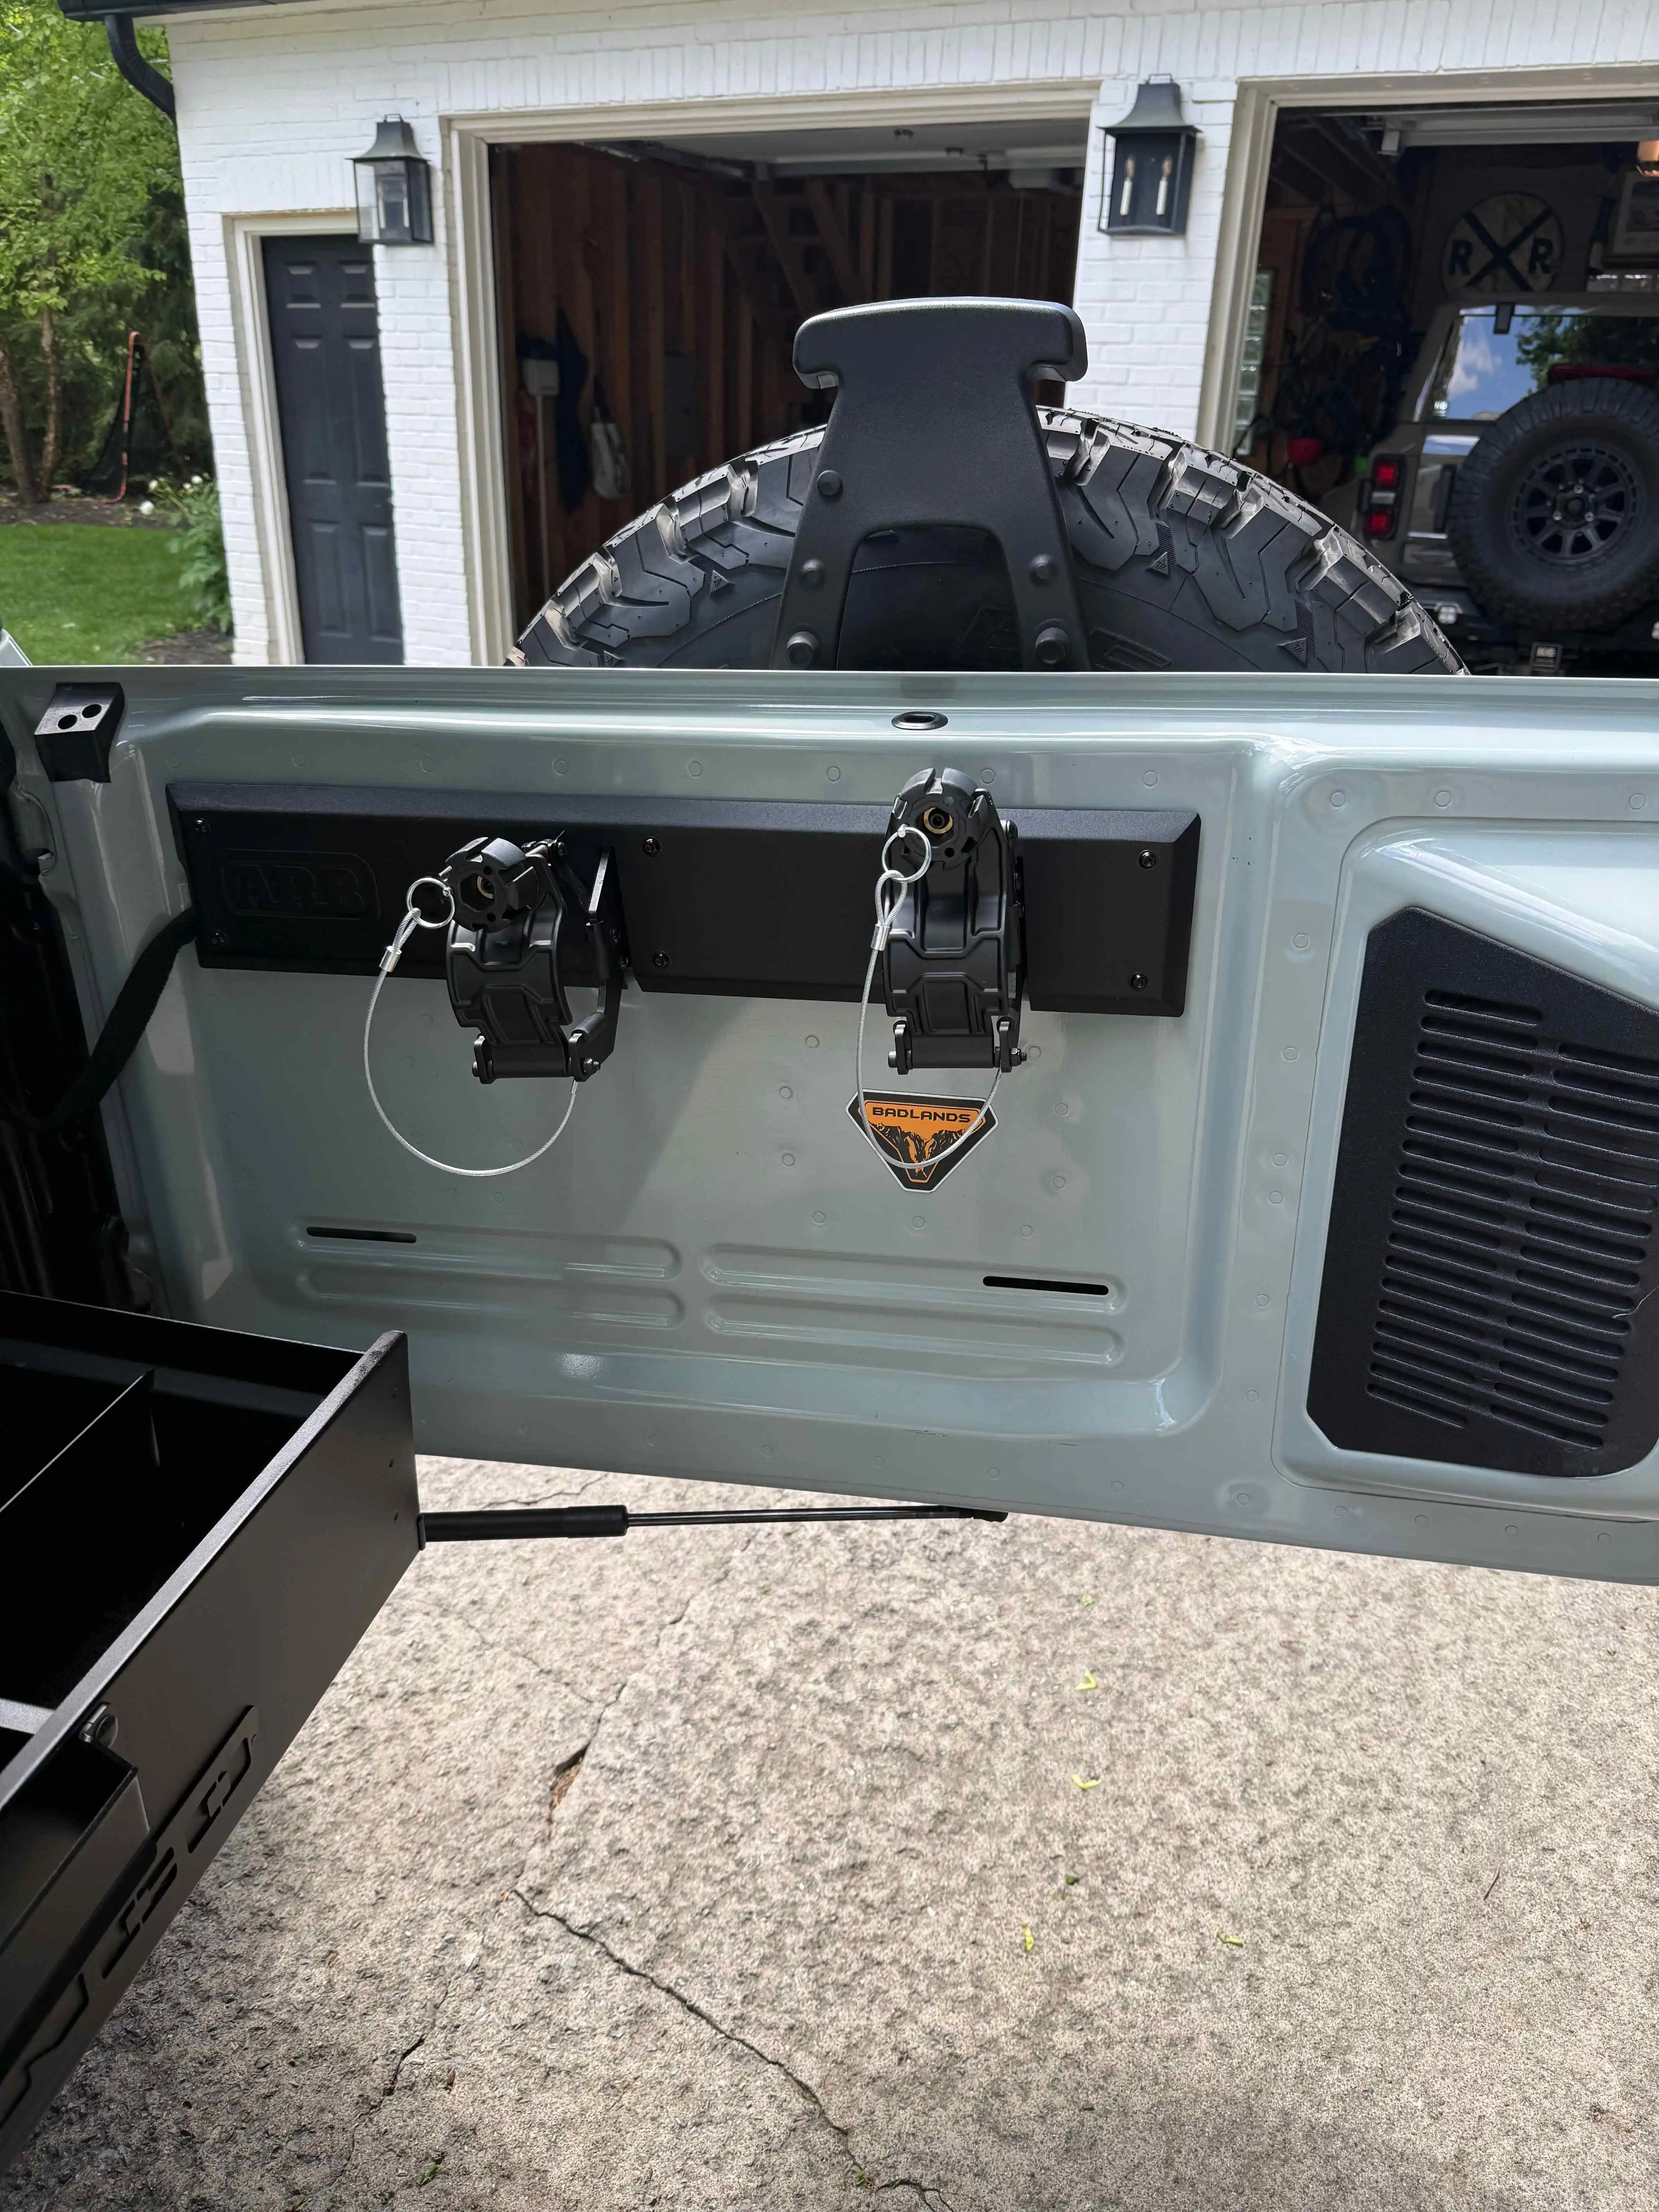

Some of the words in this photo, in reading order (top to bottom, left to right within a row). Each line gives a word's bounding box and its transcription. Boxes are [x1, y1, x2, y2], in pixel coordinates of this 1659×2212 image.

[1449, 239, 1473, 275] R
[1528, 238, 1553, 274] R
[872, 1107, 971, 1123] BADLANDS
